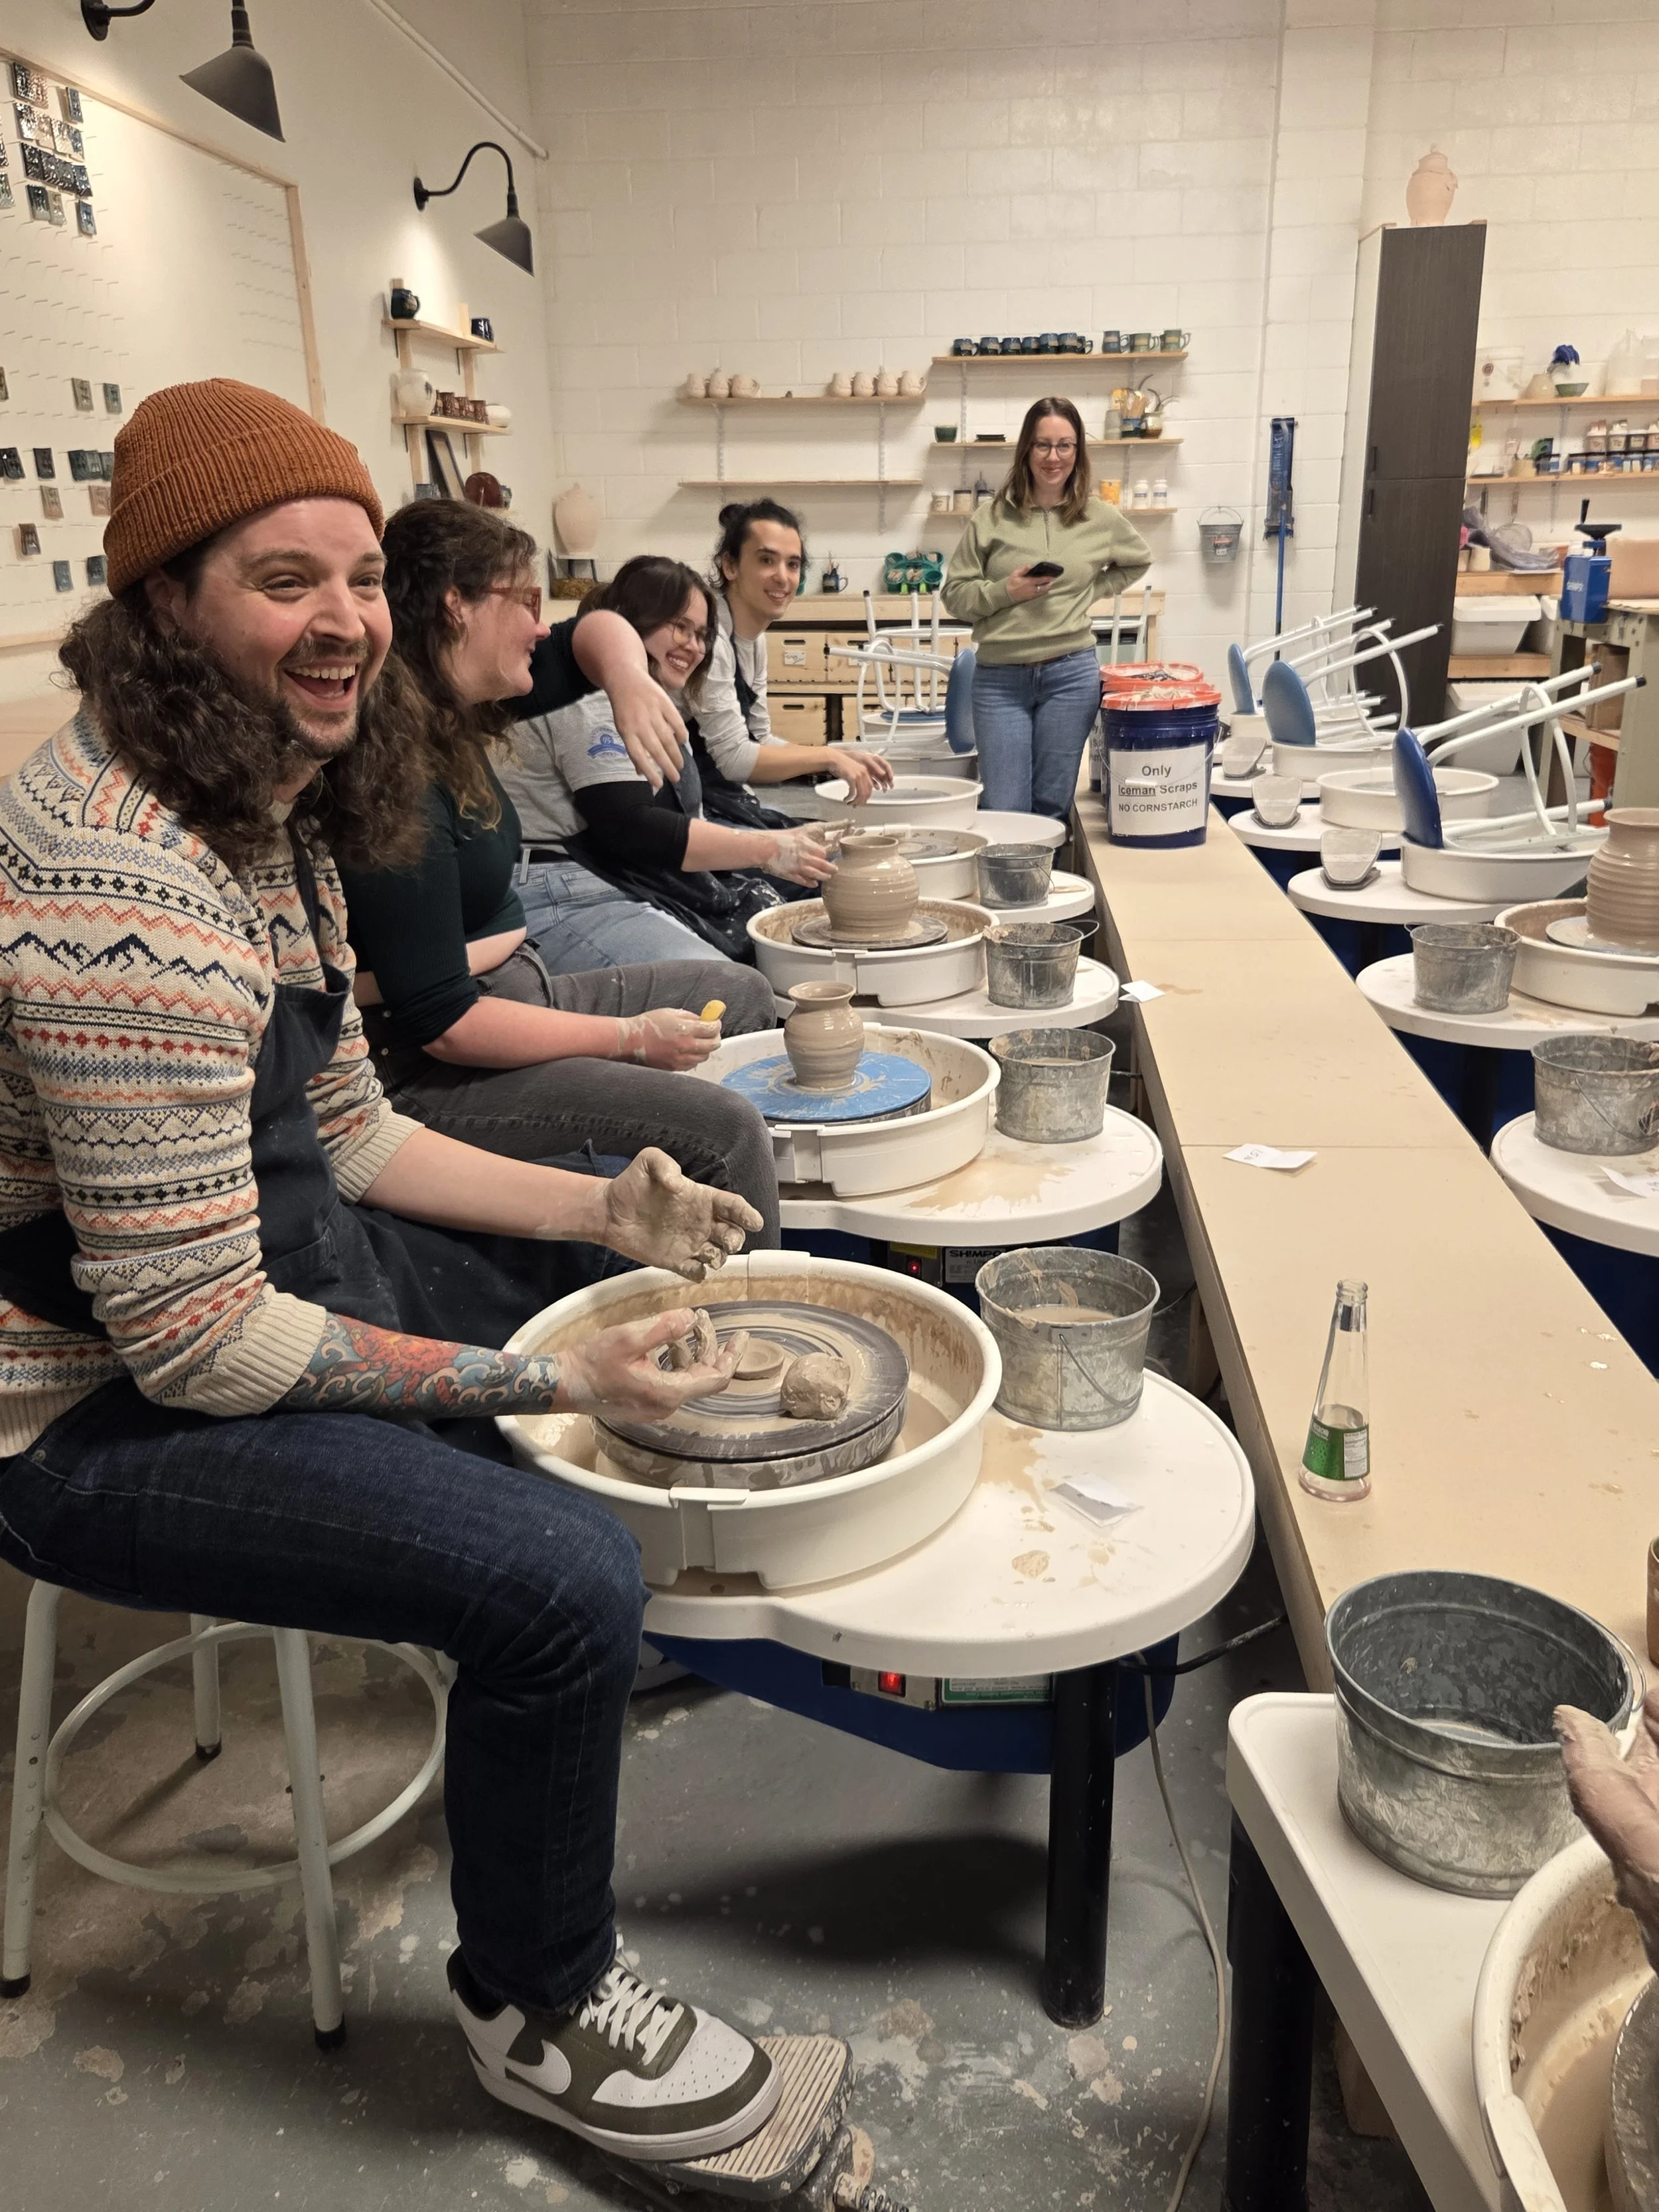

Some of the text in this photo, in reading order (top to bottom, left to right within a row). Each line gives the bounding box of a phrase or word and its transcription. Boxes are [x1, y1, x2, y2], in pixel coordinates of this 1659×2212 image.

[1141, 765, 1171, 778] Only
[1118, 782, 1198, 796] Iceman Scraps
[1119, 798, 1198, 812] NO CORNSTARCH
